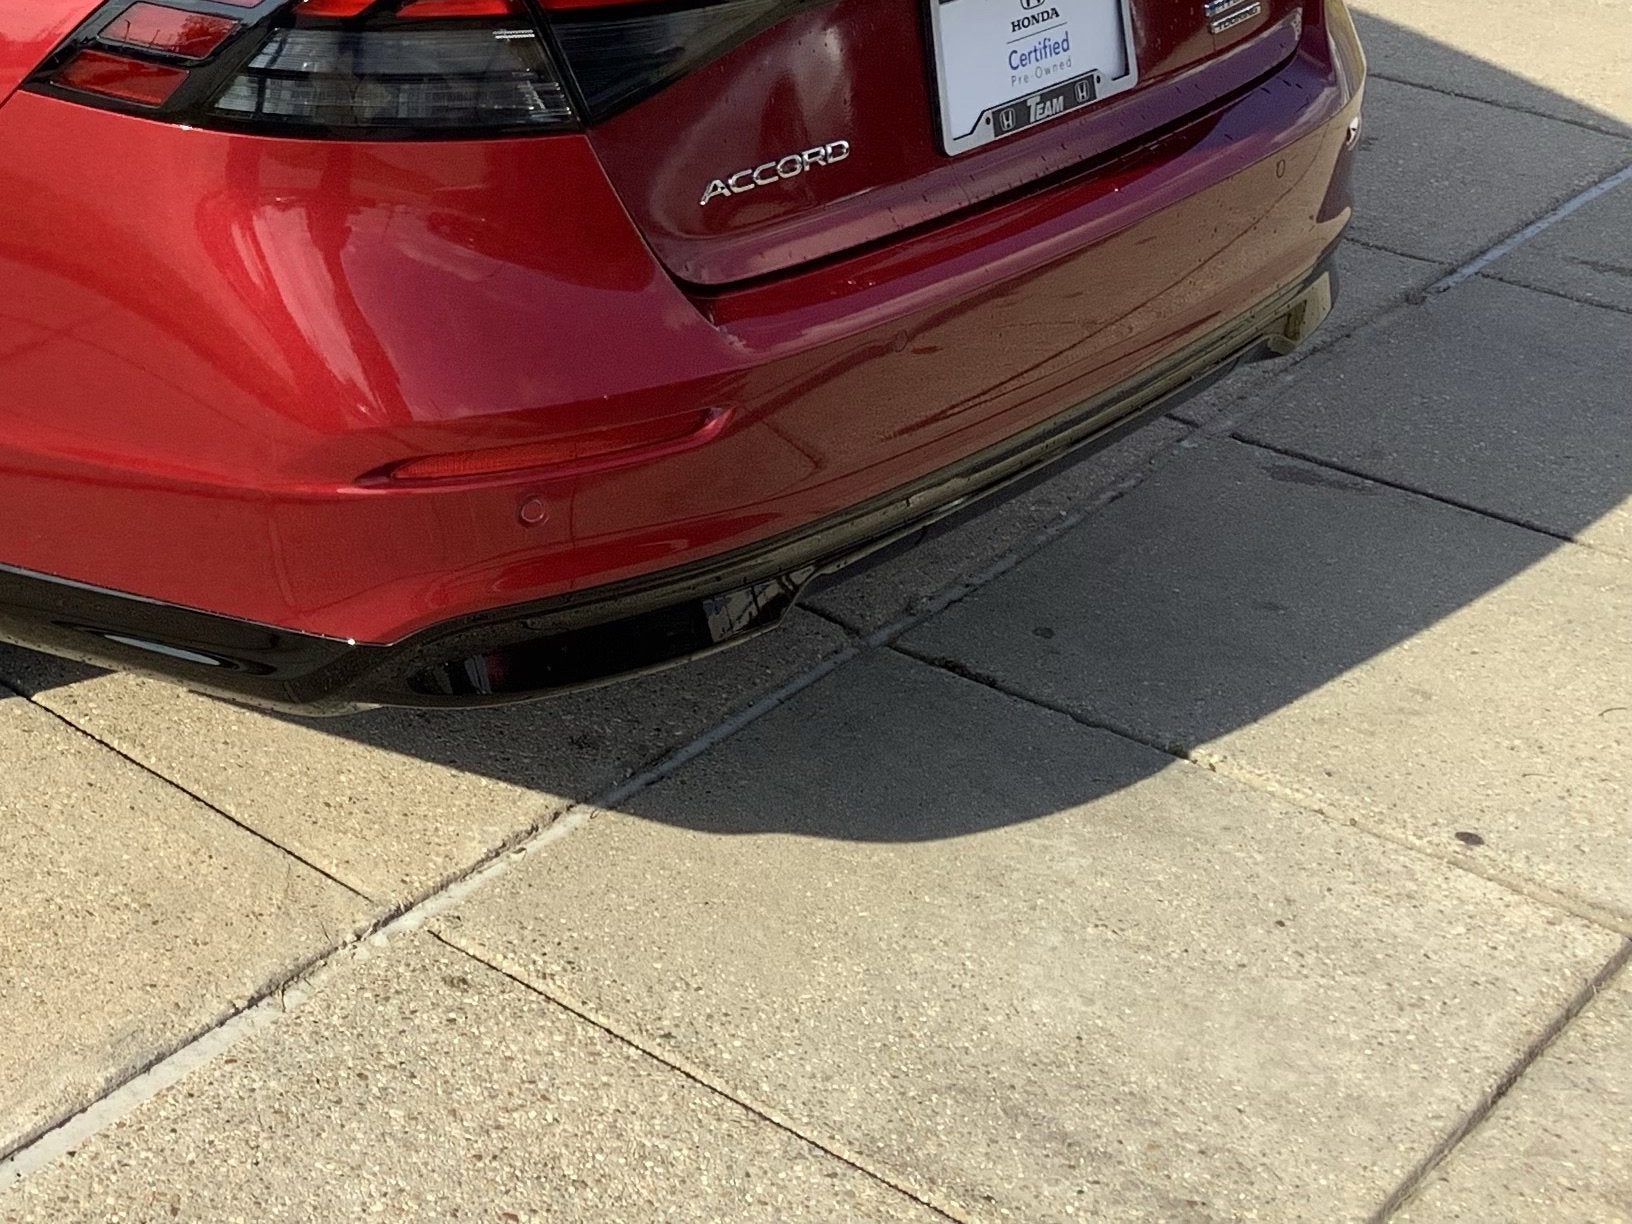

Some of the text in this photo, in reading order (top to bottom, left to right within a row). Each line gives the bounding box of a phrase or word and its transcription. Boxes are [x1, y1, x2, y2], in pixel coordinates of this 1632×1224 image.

[1010, 7, 1060, 33] HONDA
[1008, 31, 1070, 71] Certified
[1026, 94, 1064, 123] TEAM
[698, 140, 850, 206] ACCORD
